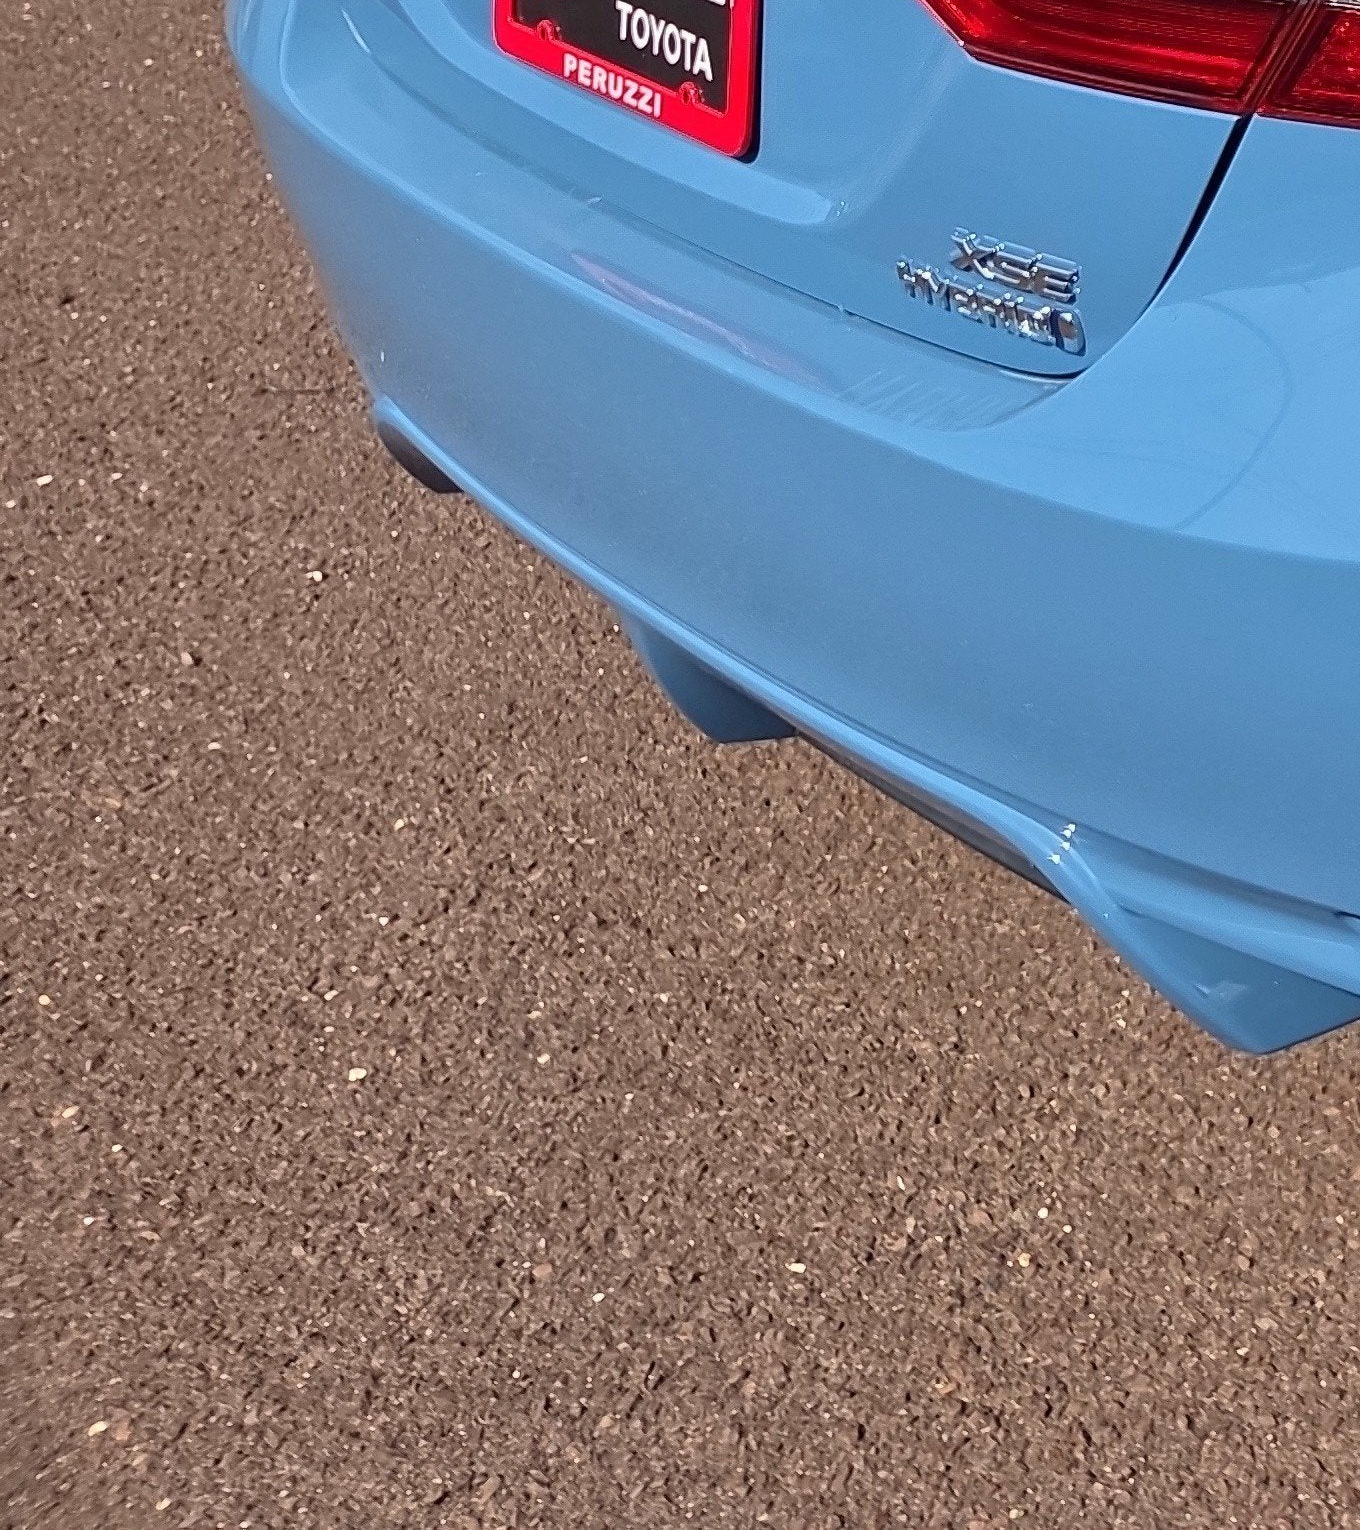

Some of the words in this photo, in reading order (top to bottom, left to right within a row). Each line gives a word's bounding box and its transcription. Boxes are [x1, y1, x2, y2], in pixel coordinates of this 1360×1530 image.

[615, 0, 713, 82] TOYOTA
[562, 52, 662, 119] PERUZZI
[896, 255, 1087, 357] HYBRID
[949, 227, 1080, 305] XSE
